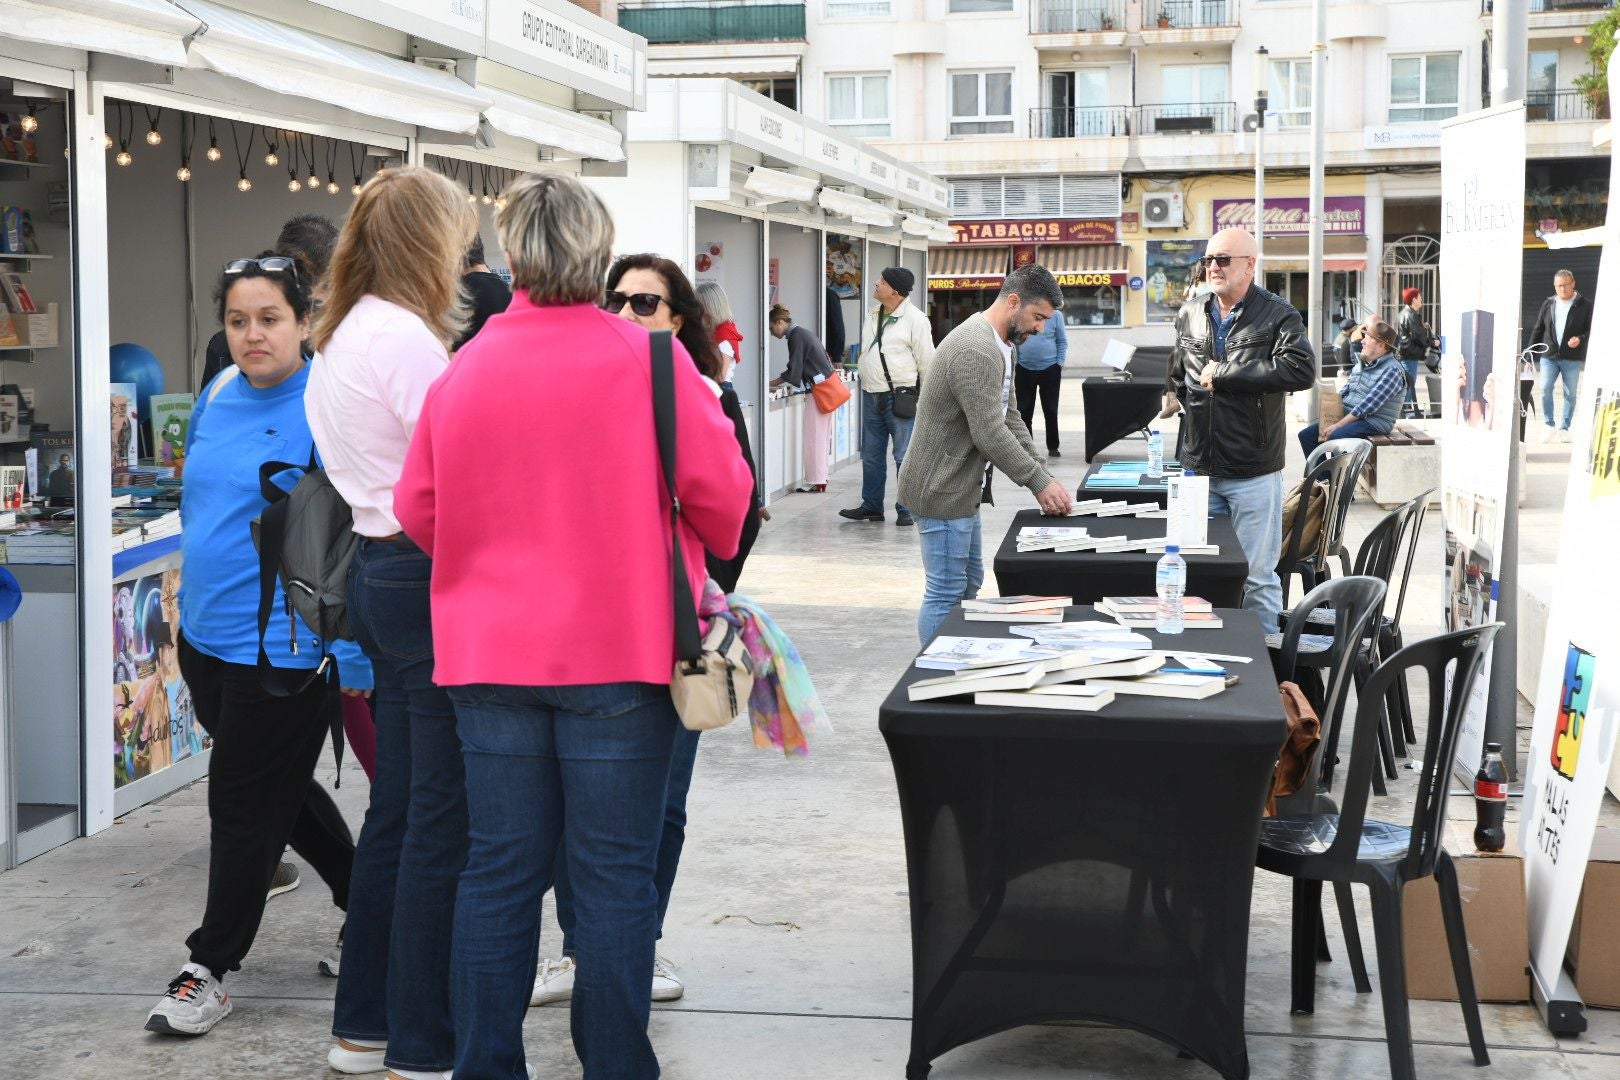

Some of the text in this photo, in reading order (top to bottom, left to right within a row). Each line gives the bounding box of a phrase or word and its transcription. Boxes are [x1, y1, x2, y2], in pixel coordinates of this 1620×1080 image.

[522, 11, 544, 44] GRUPO
[545, 21, 575, 57] EDITORIAL
[969, 222, 1060, 238] TABACOS
[928, 279, 955, 289] PUROS
